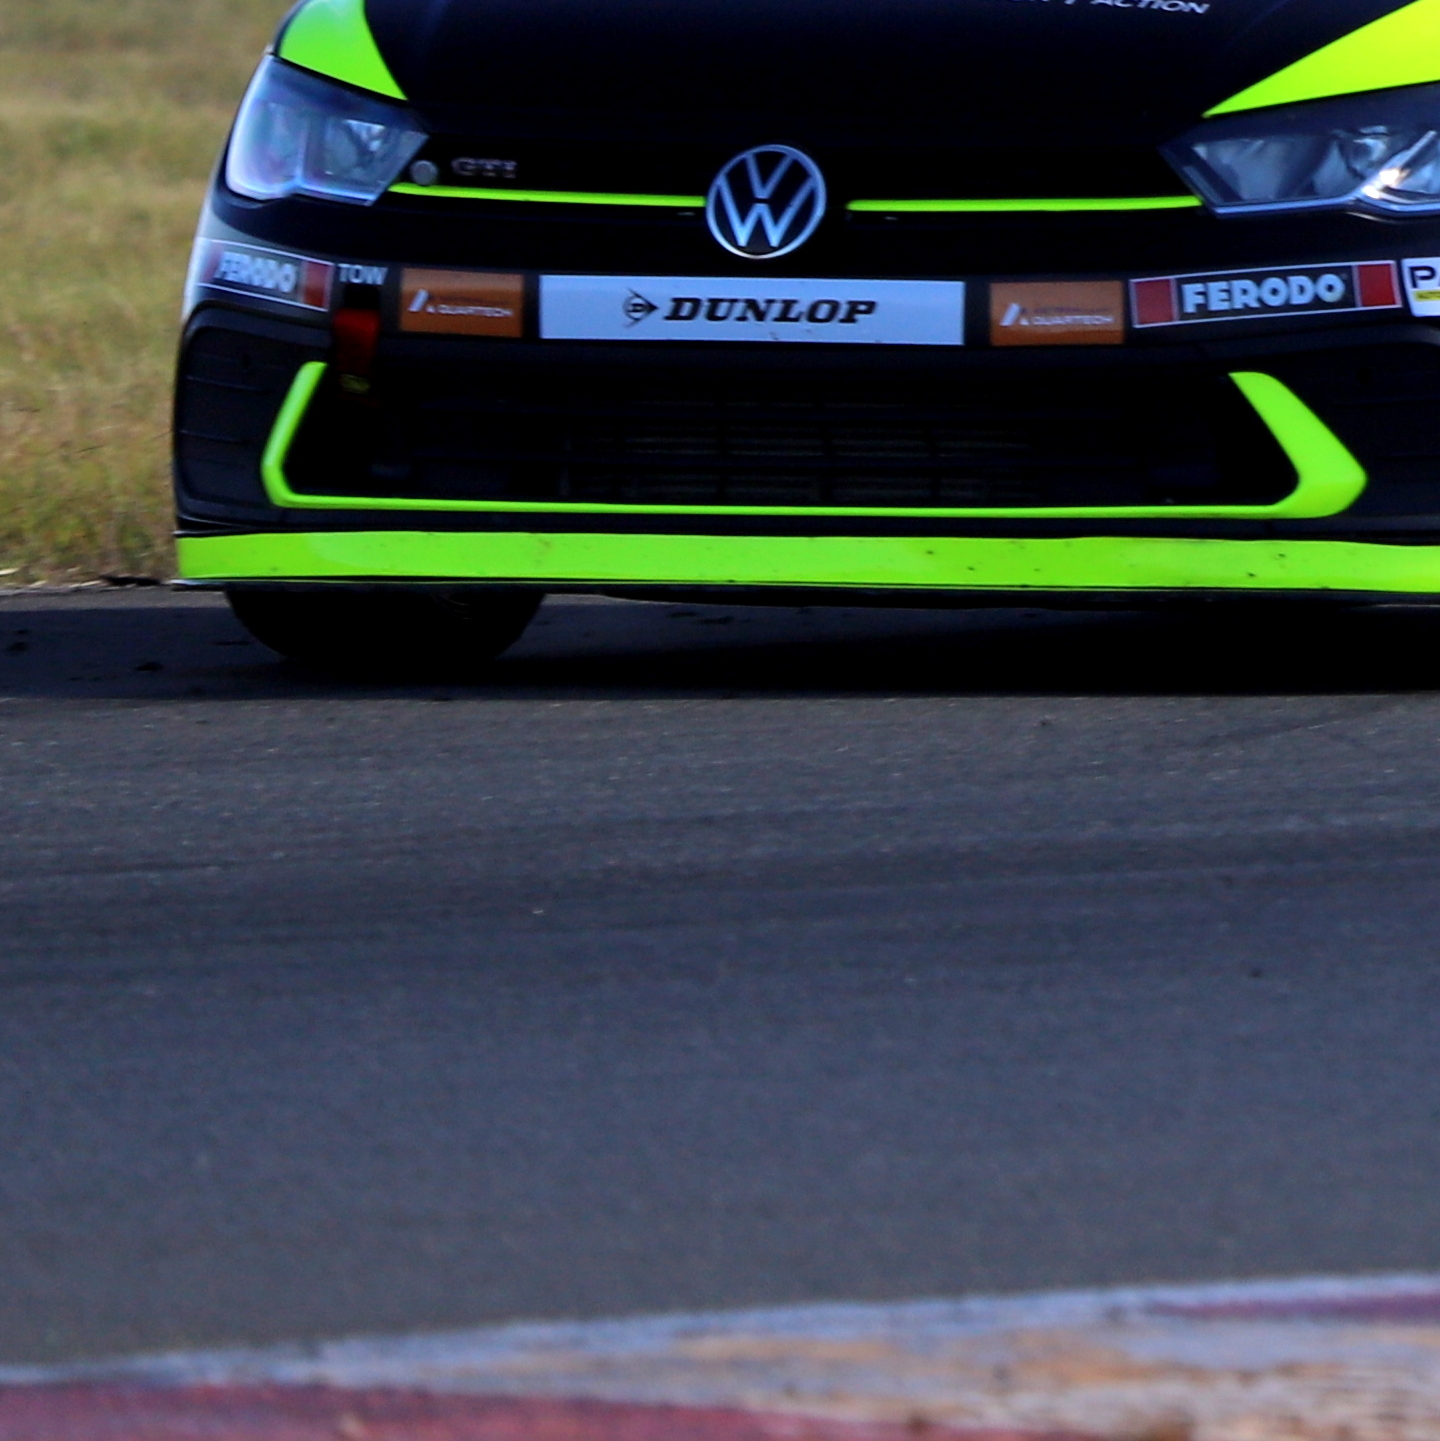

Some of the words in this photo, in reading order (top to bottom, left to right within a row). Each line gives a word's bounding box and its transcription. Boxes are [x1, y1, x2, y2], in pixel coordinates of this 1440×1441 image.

[451, 158, 518, 178] GTI
[337, 263, 388, 285] TOW
[1181, 273, 1345, 313] FERODO
[664, 297, 878, 324] DUNLOP
